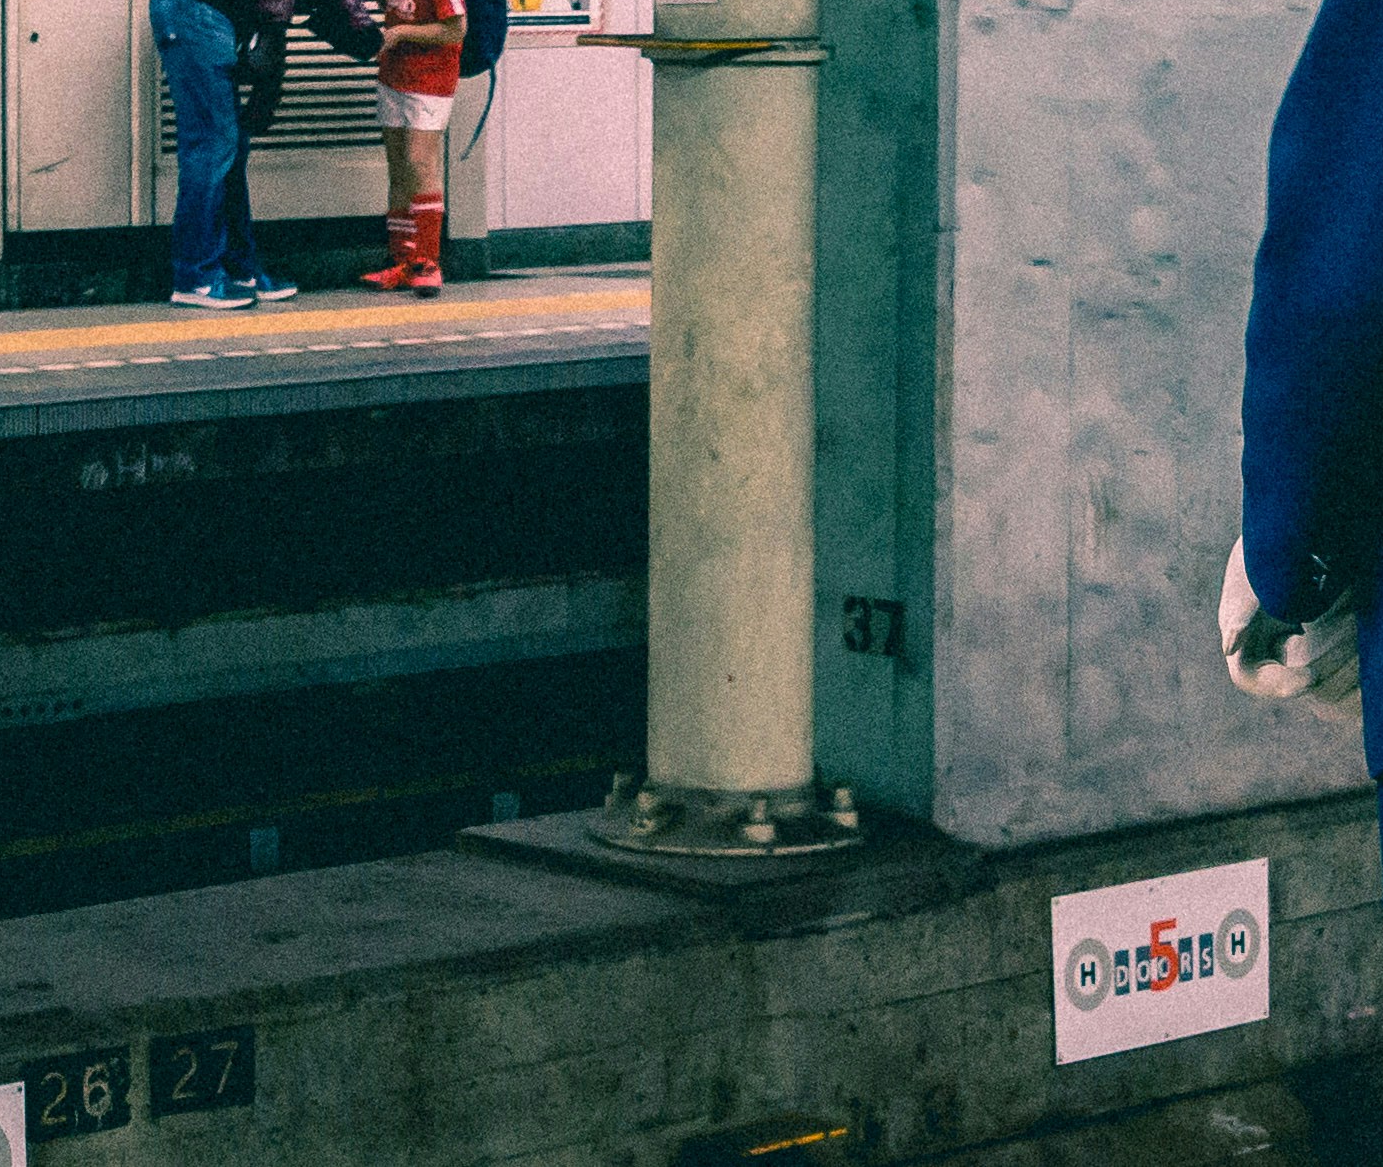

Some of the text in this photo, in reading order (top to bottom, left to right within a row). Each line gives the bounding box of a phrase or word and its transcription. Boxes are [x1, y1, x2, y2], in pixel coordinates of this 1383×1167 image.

[843, 595, 905, 656] 37
[1080, 961, 1096, 987] H
[1231, 930, 1245, 955] H
[1149, 918, 1179, 992] 5
[40, 1063, 112, 1126] 26
[172, 1040, 238, 1099] 27
